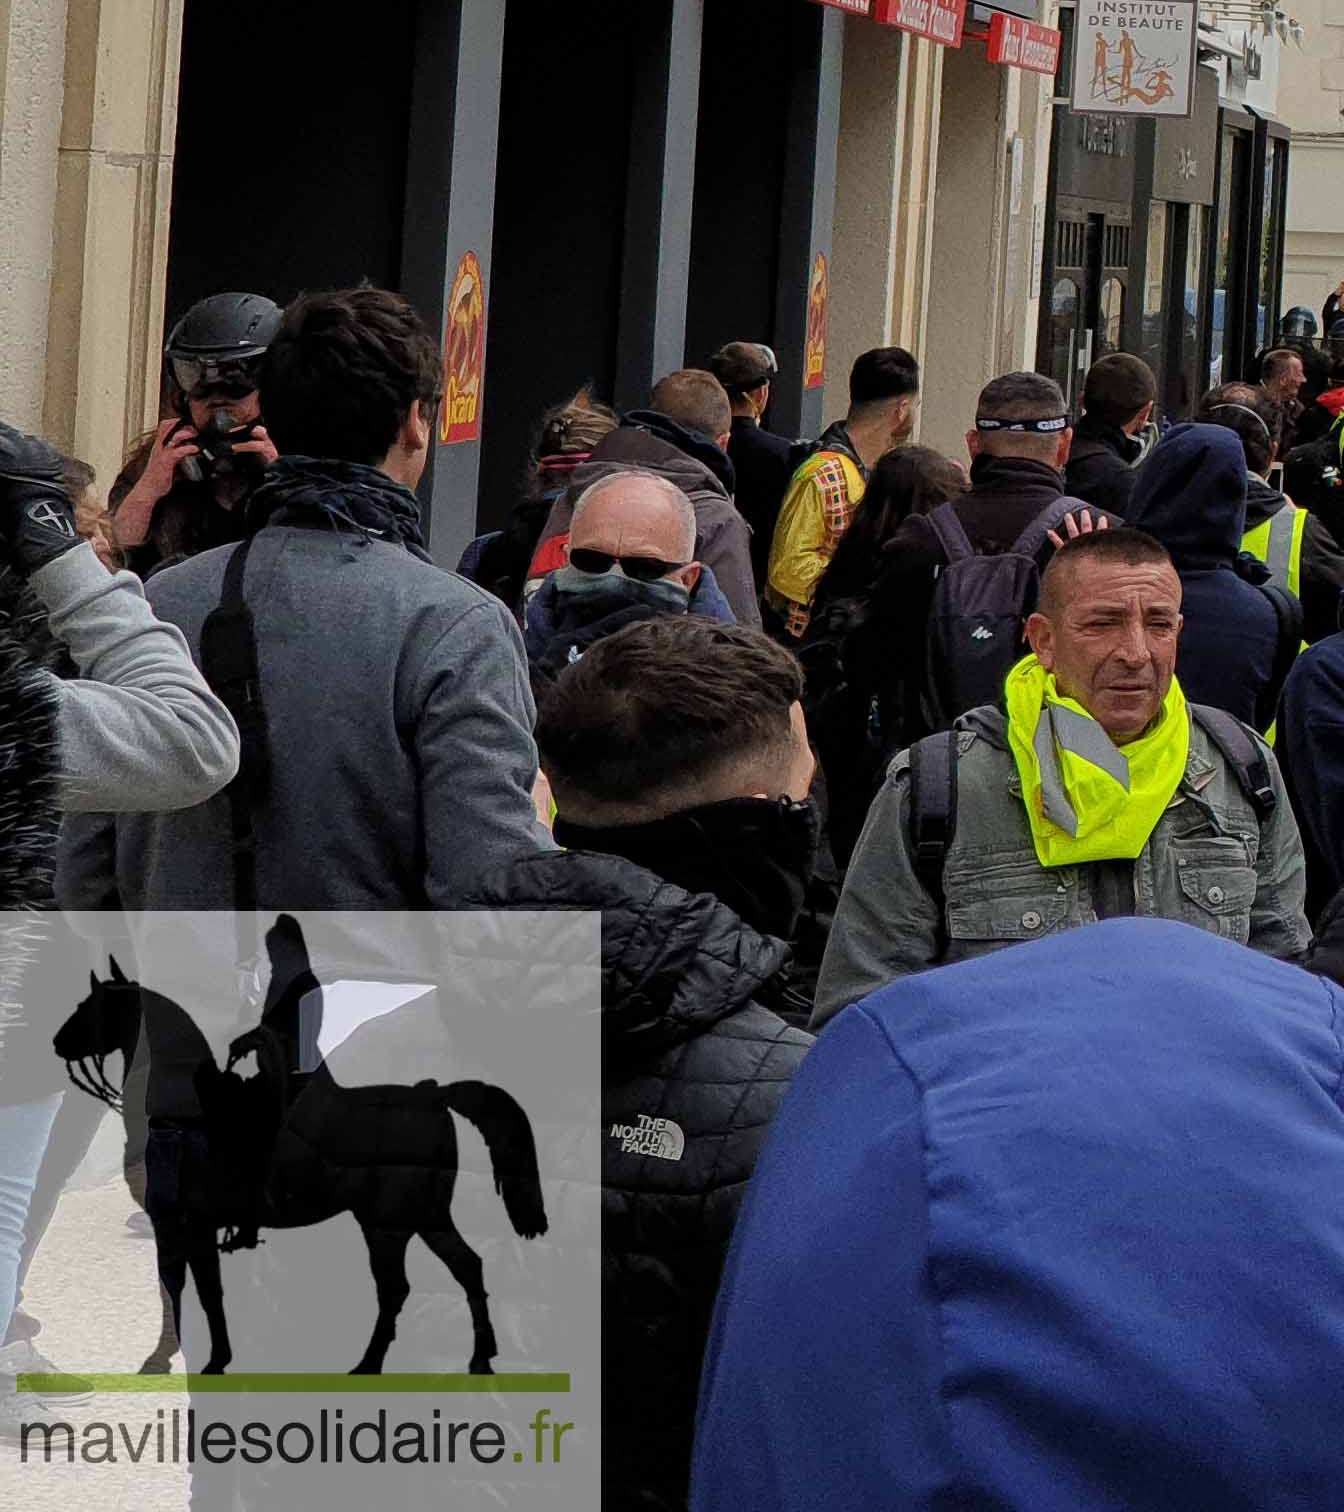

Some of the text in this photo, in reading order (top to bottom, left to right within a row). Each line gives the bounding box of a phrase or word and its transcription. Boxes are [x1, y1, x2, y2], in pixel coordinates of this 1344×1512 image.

[1097, 1, 1177, 16] INSTITUT
[1088, 15, 1185, 31] DE BEAUTE
[638, 1114, 666, 1131] THE
[610, 1123, 662, 1144] NORTH
[621, 1139, 660, 1156] FACE
